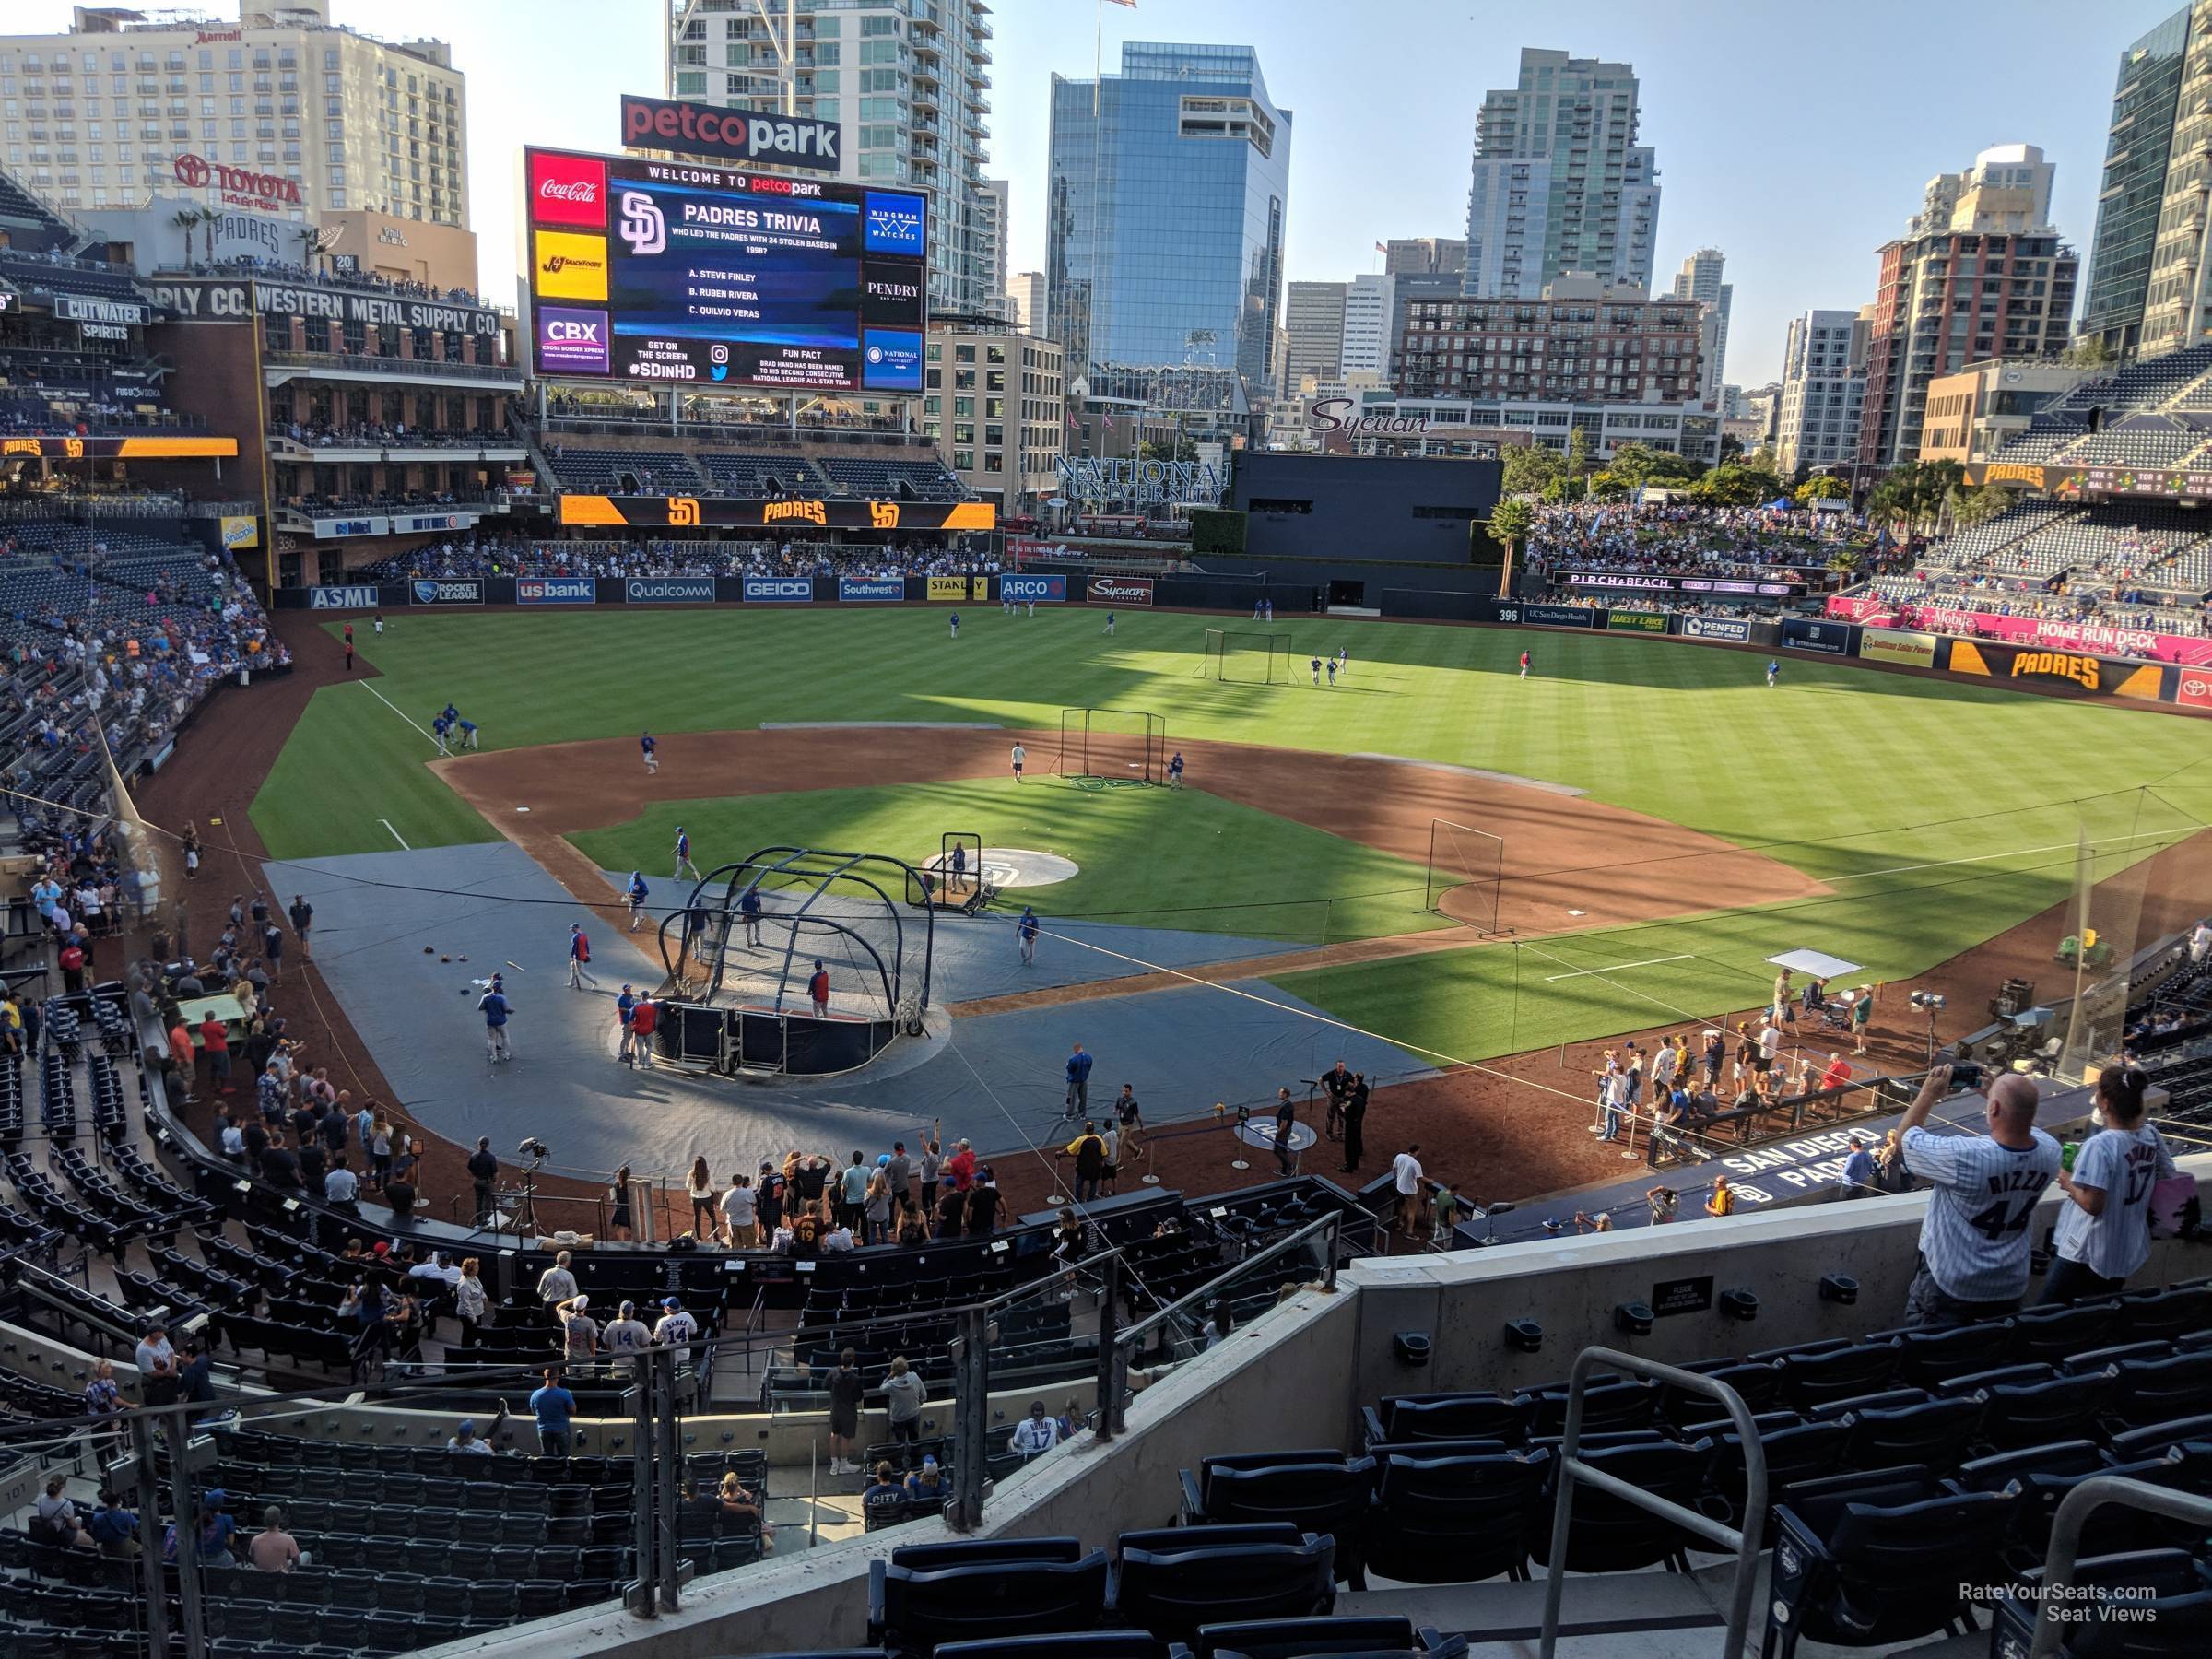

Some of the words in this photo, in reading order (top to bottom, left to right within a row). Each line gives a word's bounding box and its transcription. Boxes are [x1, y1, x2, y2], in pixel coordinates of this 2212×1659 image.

[215, 165, 301, 204] TOYOTA
[649, 167, 721, 184] WELCOME
[728, 175, 746, 188] TO
[685, 204, 759, 228] PADRES
[763, 212, 821, 233] TRIVIA
[871, 209, 917, 220] WINGMAN
[215, 217, 279, 254] PADRES
[672, 228, 689, 237] WHO
[690, 229, 704, 238] LED
[706, 230, 720, 240] THE
[721, 231, 748, 241] PADRES
[749, 234, 768, 243] WITH
[769, 236, 778, 244] 24
[779, 238, 806, 247] STOLEN
[806, 241, 830, 250] BASES
[872, 230, 916, 241] WATCHES
[336, 255, 351, 268] 20
[688, 269, 698, 277] A.
[700, 270, 726, 279] STEVE
[728, 272, 756, 282] FINLEY
[700, 288, 726, 298] RUBEN
[728, 291, 758, 300] RIVERA
[868, 282, 919, 298] PENDRY
[67, 300, 142, 323] CUTWATER
[255, 285, 344, 319] WESTERN
[352, 298, 407, 325] METAL
[411, 306, 469, 333] SUPPLY
[475, 313, 500, 335] CO.
[689, 306, 698, 314] C.
[700, 306, 731, 316] QUILVIO
[733, 309, 760, 319] VERAS
[83, 324, 128, 340] SPIRITS
[547, 321, 598, 343] CBX
[648, 341, 665, 350] GET
[665, 342, 677, 350] ON
[638, 350, 654, 359] THE
[655, 351, 688, 361] SCREEN
[782, 349, 799, 359] FUN
[801, 350, 821, 359] FACT
[885, 350, 918, 359] NATIONAL
[1308, 398, 1432, 442] Sycuan
[4, 439, 42, 456] PADRES
[1983, 464, 2045, 488] PADRES
[1068, 481, 1226, 504] UNIVERSITY
[2088, 481, 2103, 489] BAL
[763, 500, 827, 525] PADRES
[225, 524, 258, 545] Snapple
[277, 535, 297, 550] 336
[439, 583, 478, 592] ROCKET
[843, 583, 893, 594] Southwest
[931, 581, 983, 590] STANLY
[1003, 582, 1048, 594] ARCO
[1571, 574, 1618, 585] PIRCH
[1627, 577, 1668, 587] BEACH
[439, 592, 478, 600] LEAGUE
[629, 582, 712, 598] Qualcomm
[747, 582, 810, 596] GEICO
[1090, 579, 1147, 599] Sycuan
[313, 588, 377, 608] ASML
[1499, 609, 1518, 621] 396
[1568, 613, 1587, 621] Health
[1610, 615, 1637, 623] WEST
[1639, 617, 1665, 626] LAKE
[1935, 610, 1973, 629] Mobile
[1704, 621, 1745, 634] PENFED
[2037, 622, 2081, 640] HOME
[2083, 626, 2114, 645] RUN
[2116, 631, 2158, 650] DECK
[2011, 653, 2100, 690] PADRES
[1723, 1147, 1797, 1175] SAN
[1988, 1171, 2049, 1195] RIZZO
[2124, 1163, 2154, 1206] 17
[1971, 1197, 2038, 1240] 44
[800, 1229, 815, 1241] 19
[617, 1331, 632, 1345] 14
[668, 1327, 687, 1344] 14
[1032, 1430, 1051, 1449] 17
